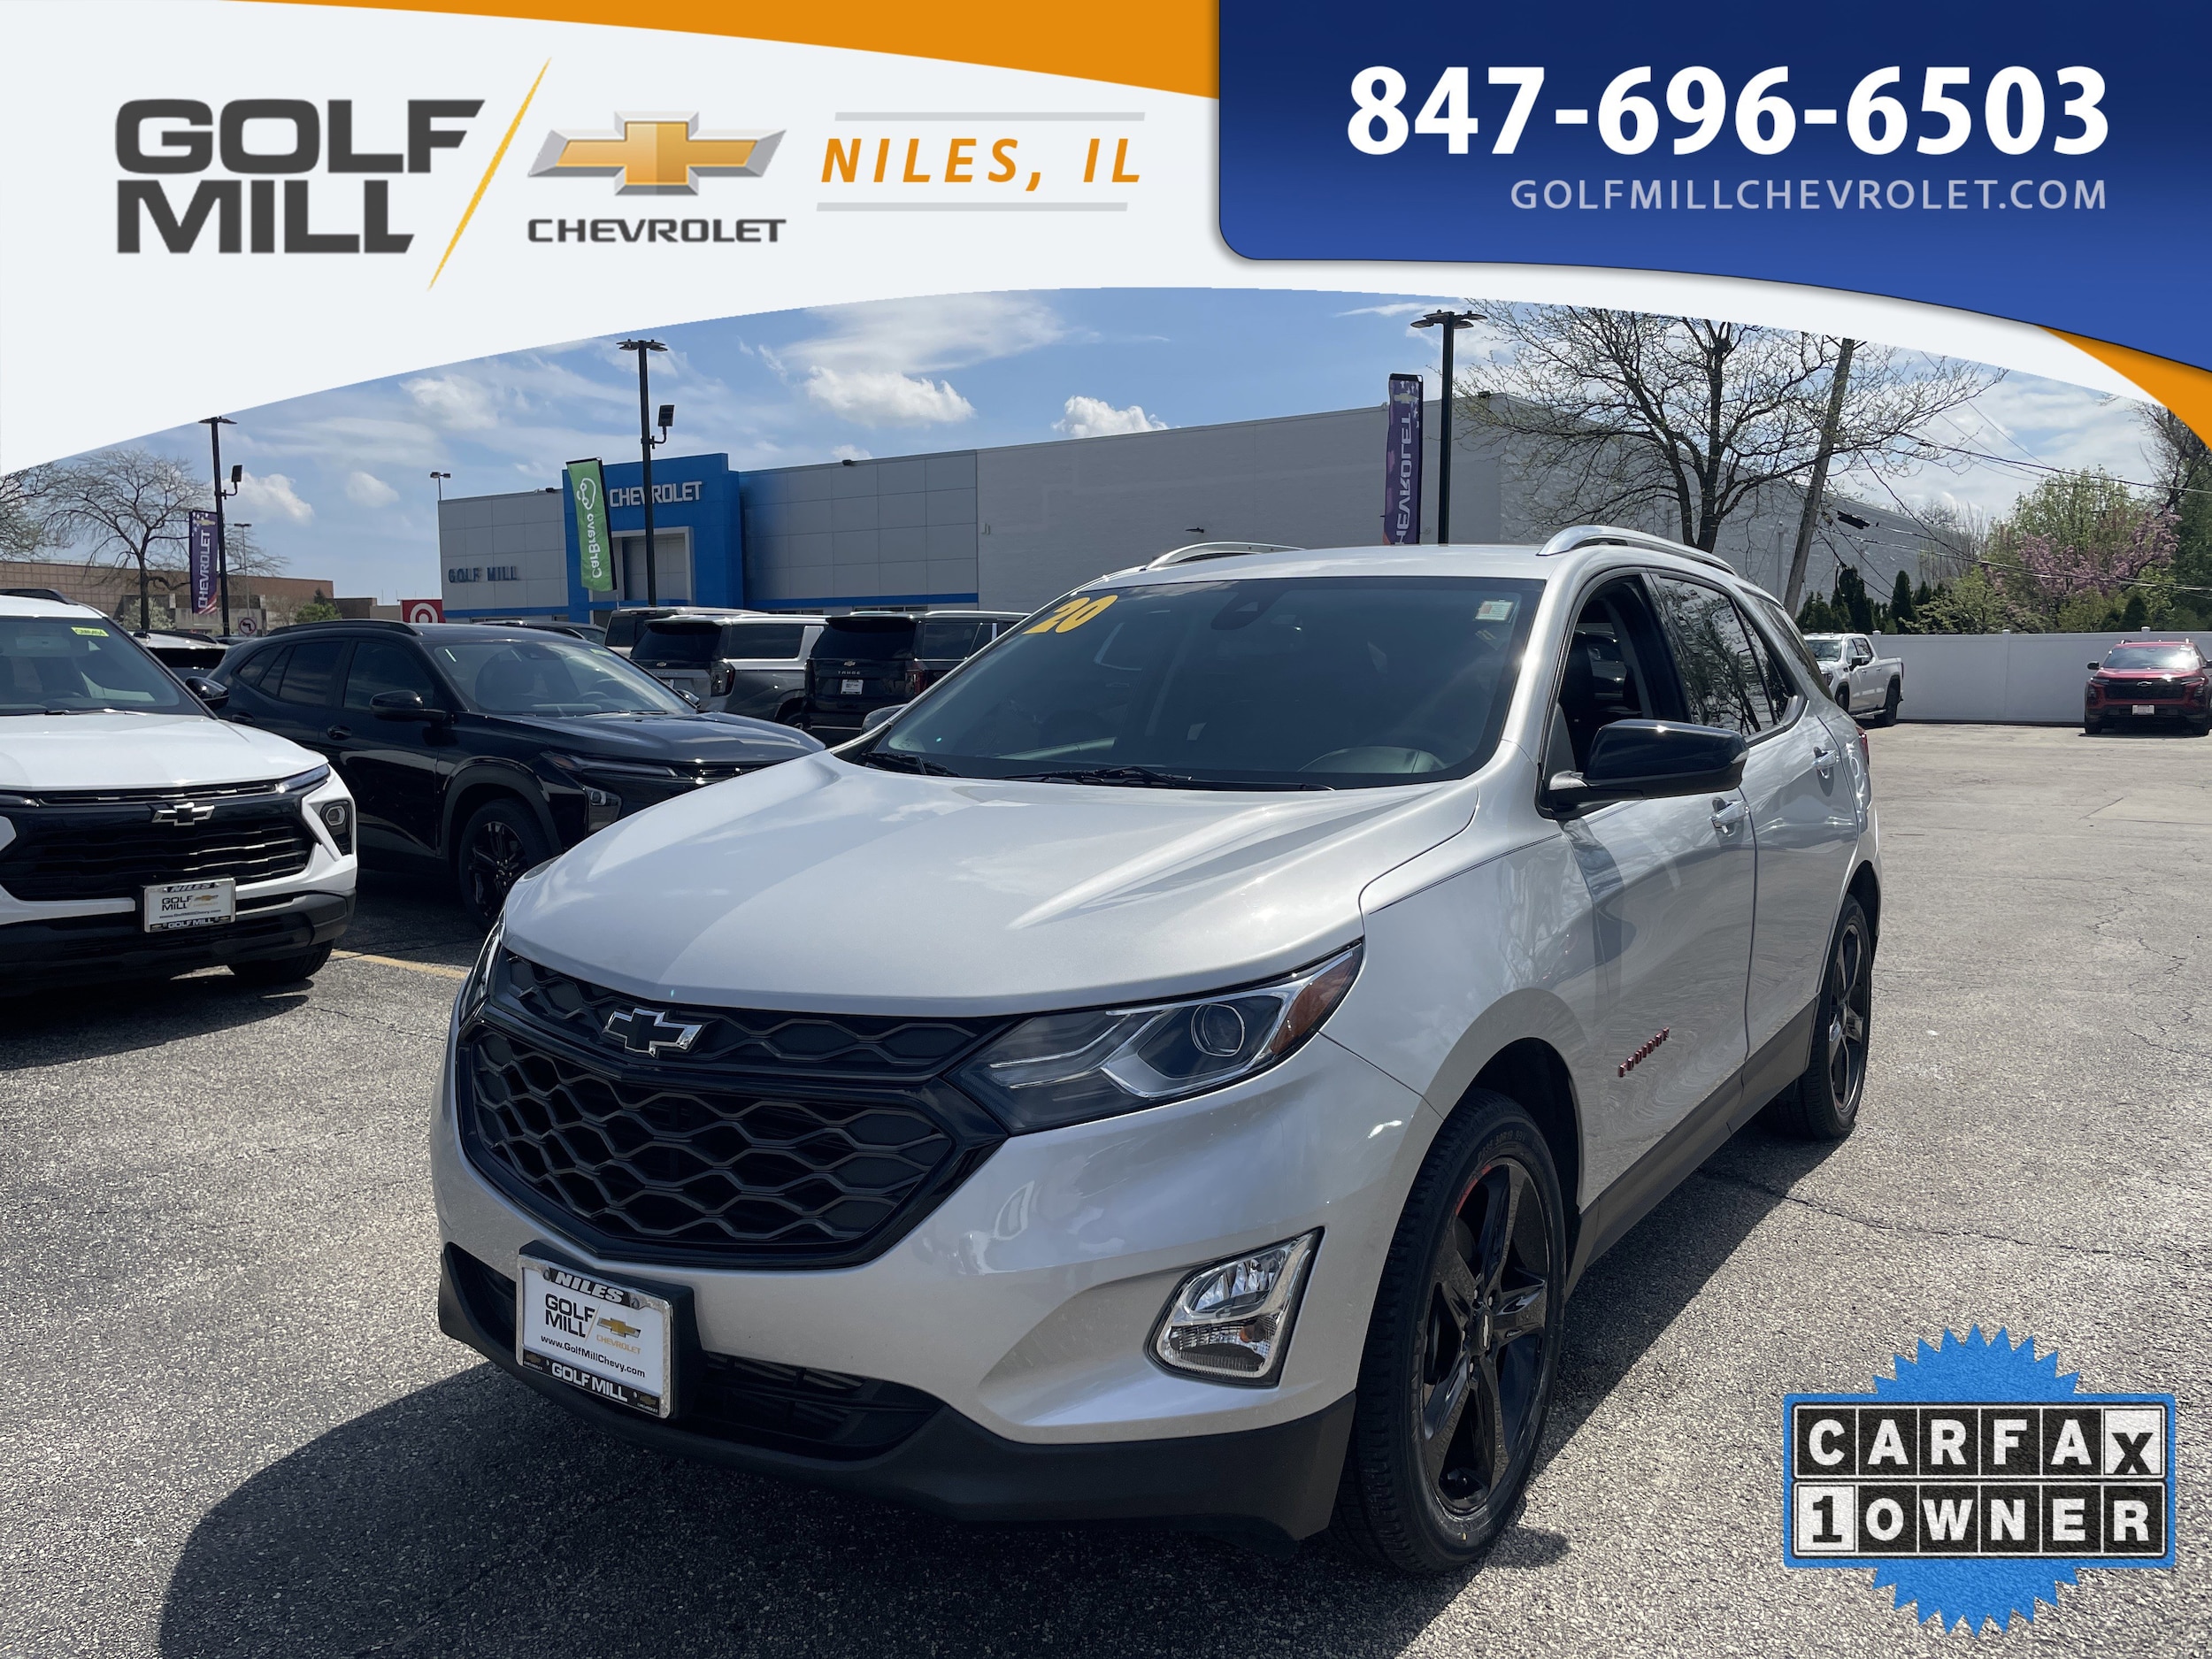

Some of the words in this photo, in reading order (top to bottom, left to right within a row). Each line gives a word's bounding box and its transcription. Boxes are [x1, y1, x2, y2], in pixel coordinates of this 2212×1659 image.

[197, 529, 211, 608] CHEVROLET
[449, 567, 480, 583] GOLF
[487, 566, 517, 580] MILL
[1022, 595, 1118, 634] 20
[161, 895, 193, 904] GOLF
[170, 883, 211, 893] NILES
[161, 902, 187, 911] MILL
[167, 920, 192, 929] GOLF
[192, 918, 214, 926] MILL
[555, 1271, 625, 1303] NILES
[545, 1293, 595, 1322] GOLF
[545, 1310, 587, 1339] MILL
[541, 1334, 646, 1379] www.GolfMillChevy.com
[596, 1333, 641, 1356] CHEVROLET
[551, 1362, 591, 1387] GOLF
[591, 1378, 628, 1402] MILL
